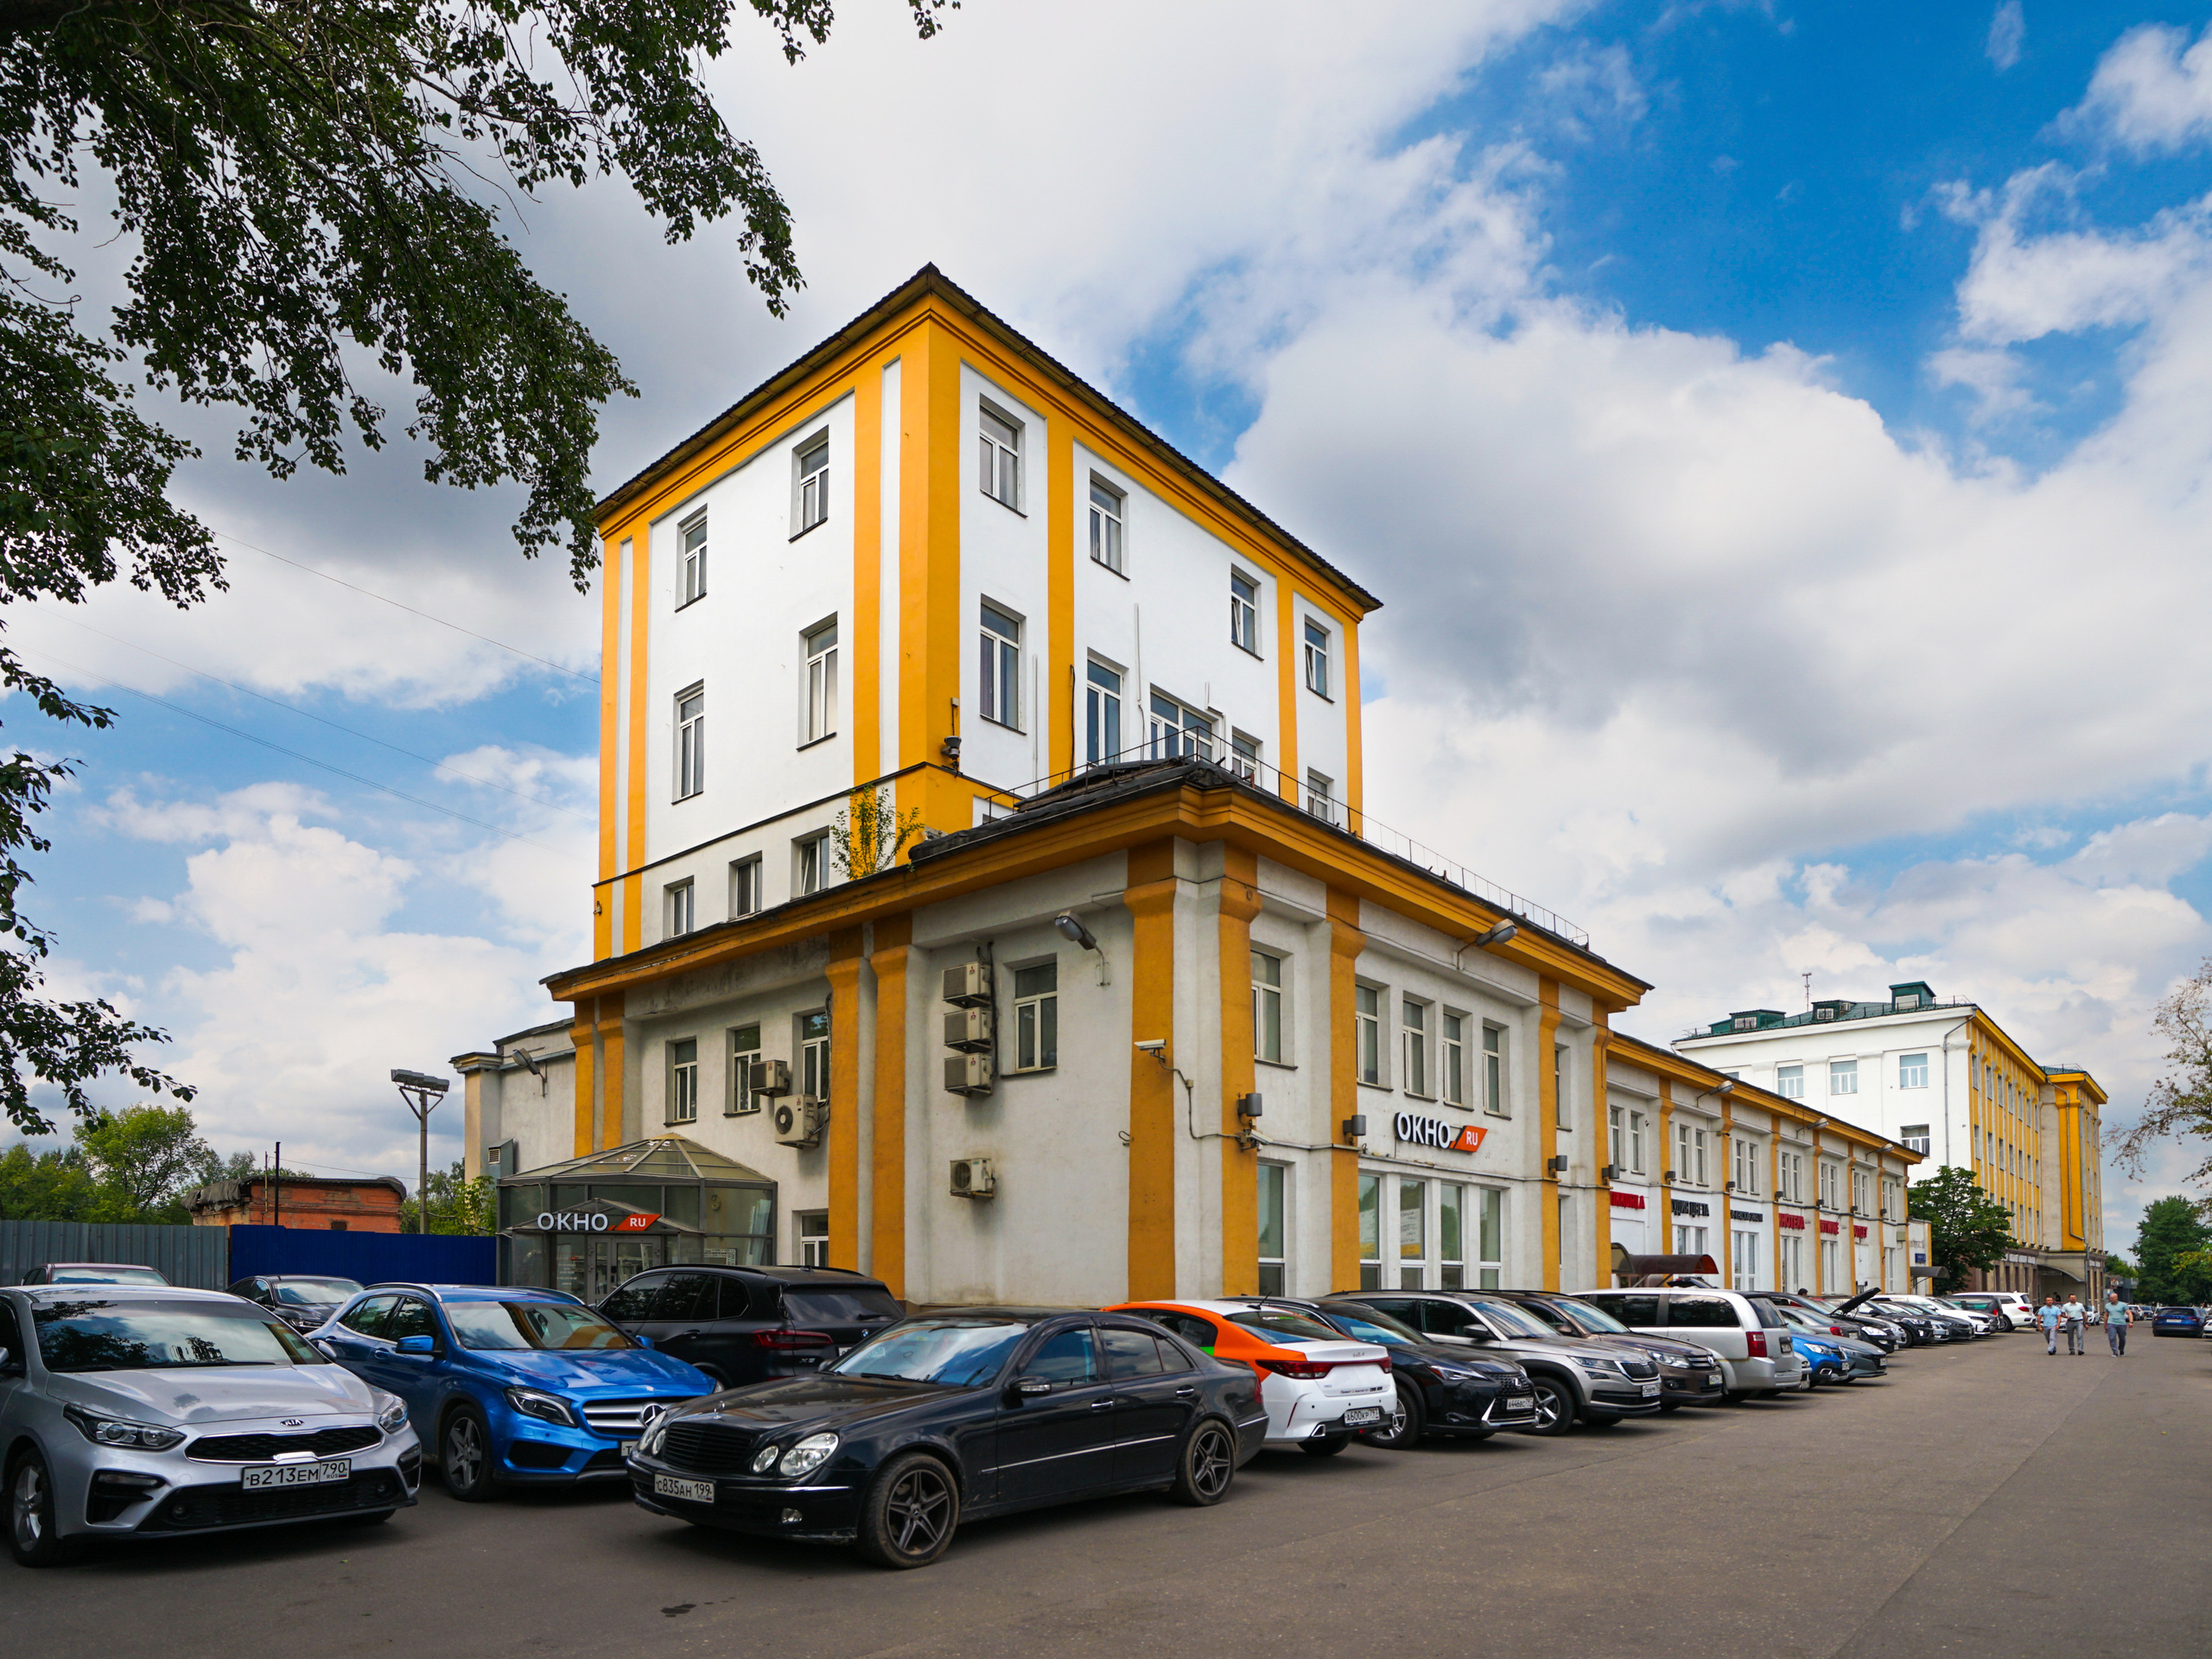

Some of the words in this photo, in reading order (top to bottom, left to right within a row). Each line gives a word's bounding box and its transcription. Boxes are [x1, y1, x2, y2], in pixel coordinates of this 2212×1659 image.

[1394, 1111, 1451, 1149] ОКНО
[1466, 1130, 1478, 1146] RU
[537, 1212, 608, 1231] ОКНО
[629, 1217, 646, 1227] RU
[250, 1467, 319, 1486] В213ЕМ
[321, 1462, 346, 1475] 790
[657, 1478, 692, 1497] С835АН
[694, 1483, 711, 1496] 199
